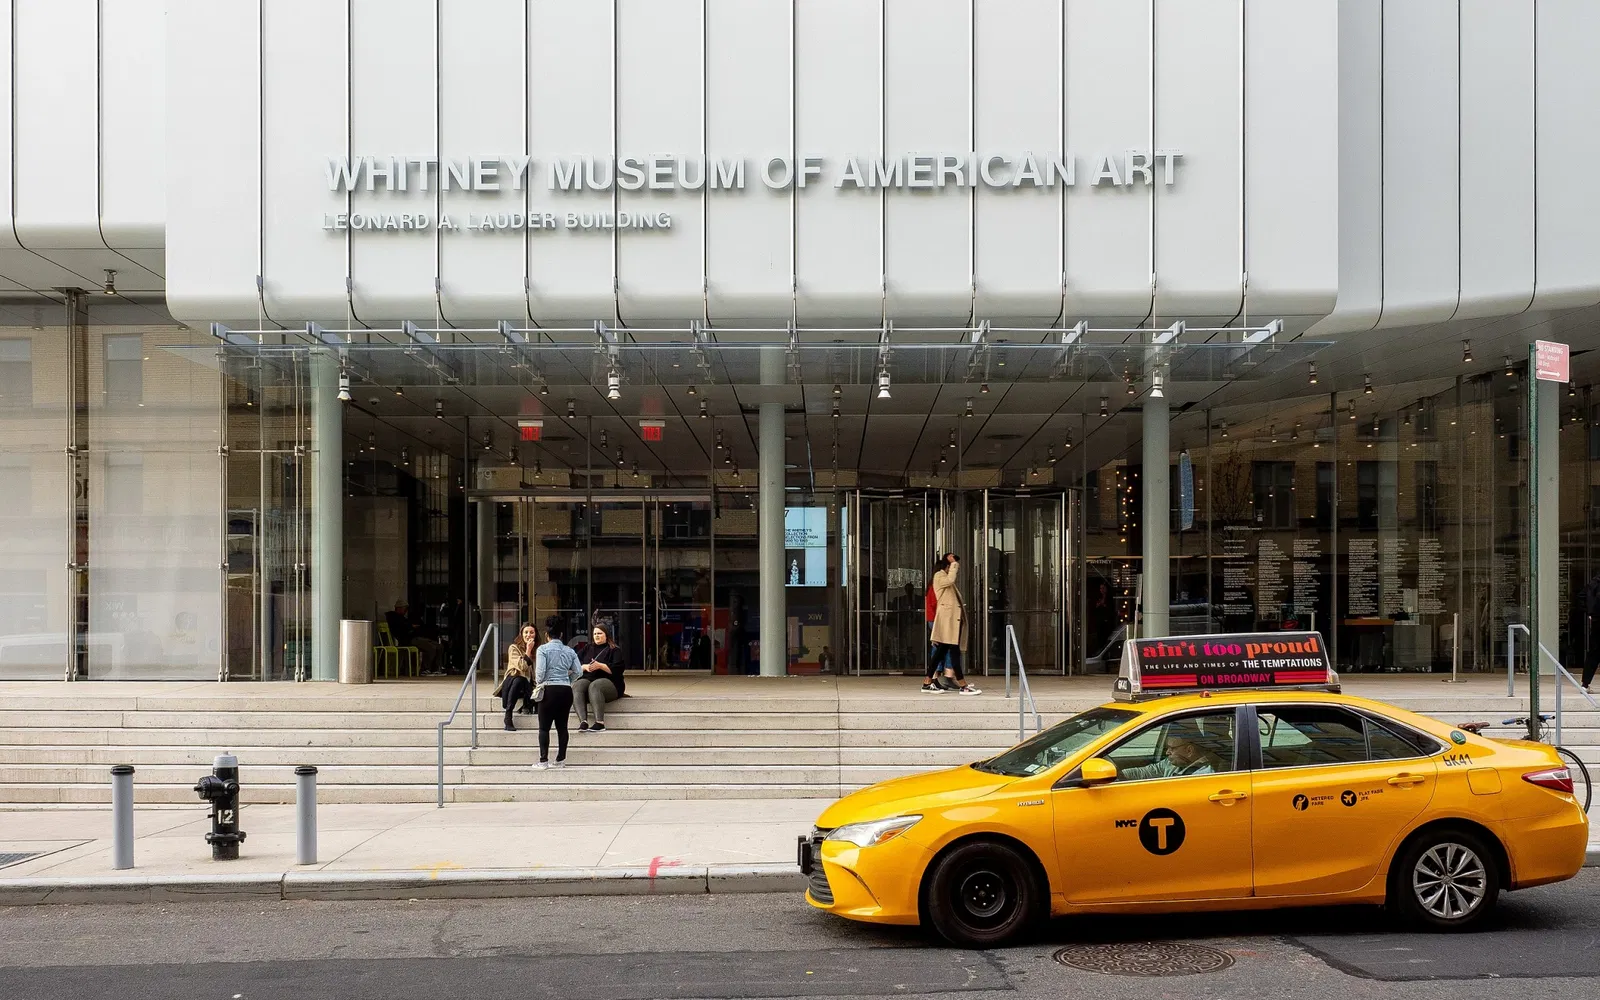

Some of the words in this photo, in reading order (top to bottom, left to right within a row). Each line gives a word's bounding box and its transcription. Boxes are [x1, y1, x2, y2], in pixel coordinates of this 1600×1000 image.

[323, 154, 533, 192] WHITNEY
[548, 153, 746, 191] MUSEUM
[760, 152, 823, 189] OF
[834, 151, 1075, 188] AMERICAN
[1090, 150, 1184, 187] ART
[322, 211, 430, 231] LEONARD
[437, 211, 461, 231] A.
[466, 211, 556, 230] LAUDER
[564, 210, 672, 229] BUILDING
[1143, 641, 1198, 658] ain't
[1203, 641, 1242, 656] too
[1245, 637, 1320, 659] proud
[1242, 660, 1260, 668] THE
[1261, 658, 1322, 668] TEMPTATIONS
[1201, 675, 1215, 684] ON
[1217, 673, 1271, 684] BROADWAY
[217, 809, 234, 825] 12
[1115, 819, 1137, 828] NYC
[1149, 817, 1175, 850] T
